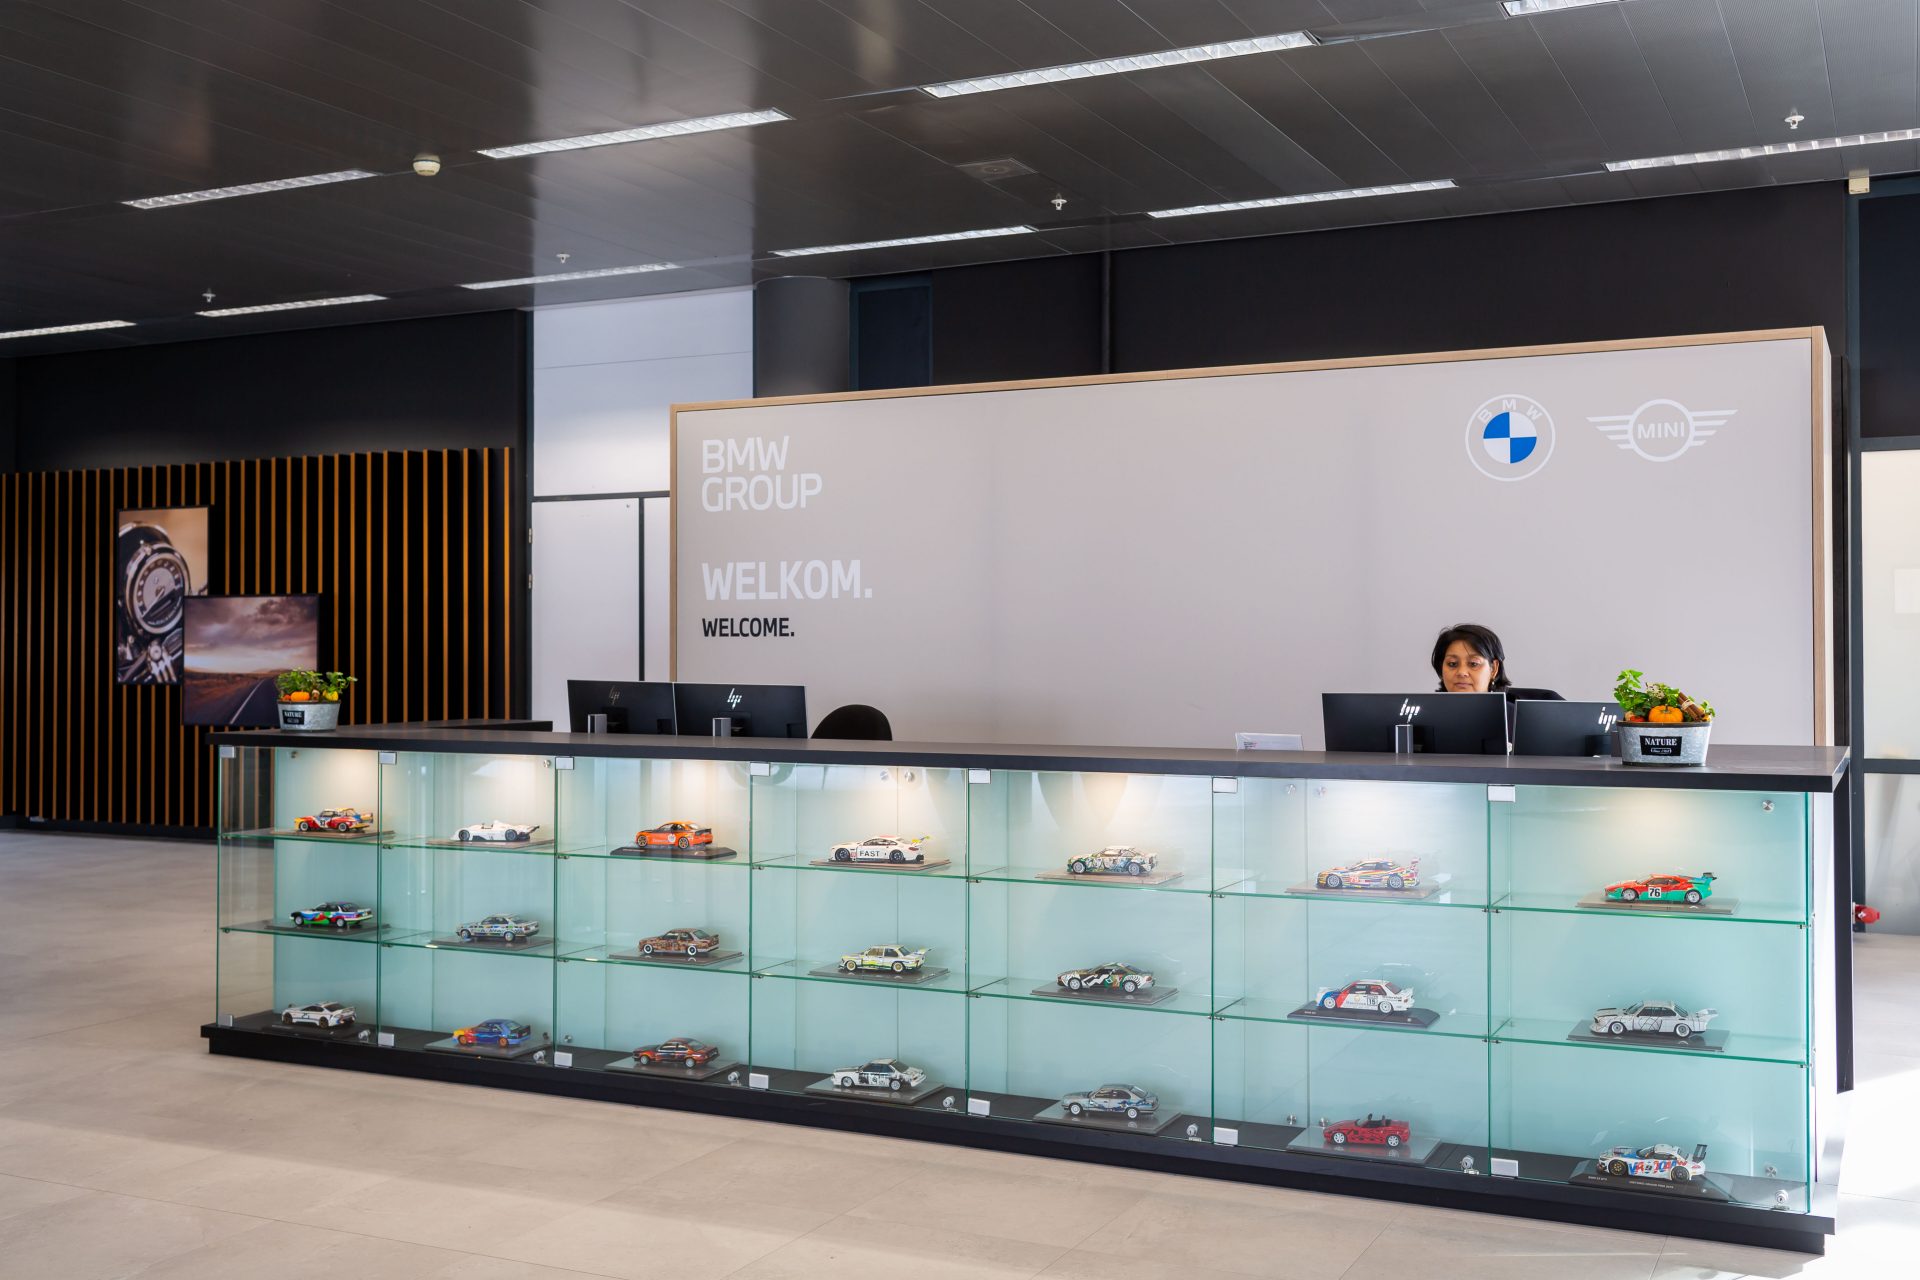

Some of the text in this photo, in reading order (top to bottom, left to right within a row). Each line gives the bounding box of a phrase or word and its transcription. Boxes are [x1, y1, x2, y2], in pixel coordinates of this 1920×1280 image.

[1477, 399, 1542, 423] BMW
[1637, 422, 1685, 440] MINI
[702, 435, 790, 474] BMW
[701, 473, 823, 512] GROUP
[702, 559, 873, 600] WELKOM.
[702, 617, 795, 638] WELCOME.
[727, 688, 743, 710] hp
[1400, 698, 1420, 723] hp
[1598, 706, 1617, 732] hp
[1645, 737, 1677, 746] NATURE
[1649, 887, 1661, 898] 76
